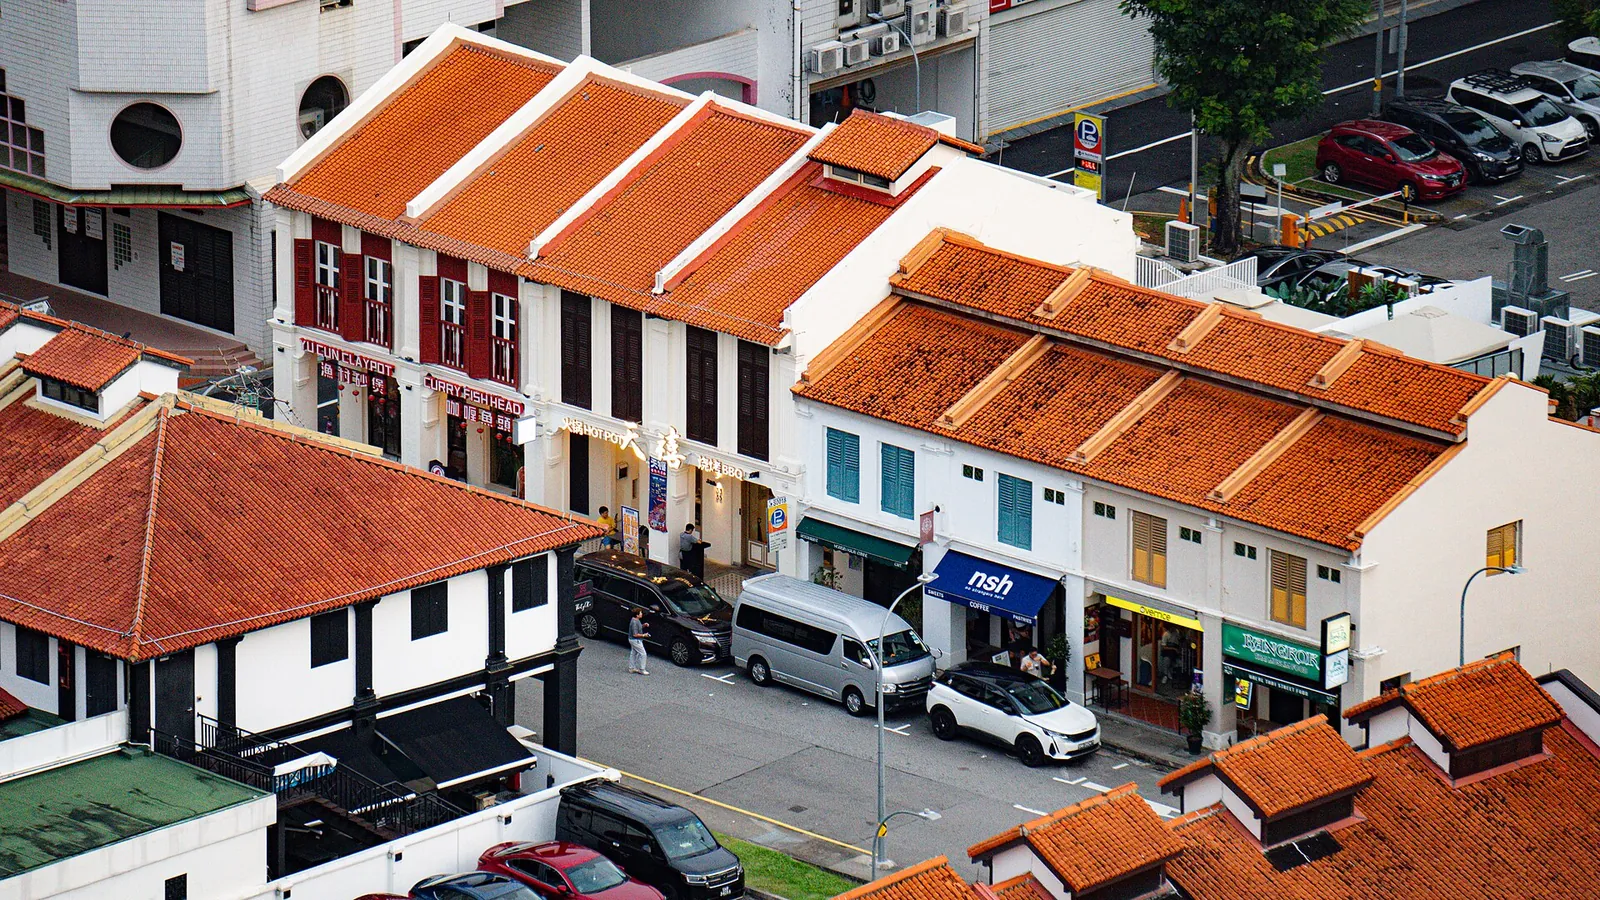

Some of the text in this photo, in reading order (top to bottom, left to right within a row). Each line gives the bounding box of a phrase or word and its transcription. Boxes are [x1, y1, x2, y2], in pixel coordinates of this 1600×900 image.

[1082, 121, 1096, 139] P
[301, 340, 392, 377] YU CUN CLAYPOT
[424, 377, 521, 415] CURRY FISH HEAD
[446, 399, 511, 433] 咖喱魚頭
[584, 423, 604, 440] HOT
[605, 430, 623, 446] POT
[722, 464, 744, 481] BBQ
[927, 589, 945, 599] SWEETS
[967, 570, 1014, 596] nsh
[969, 601, 990, 613] COFFEE
[1012, 614, 1033, 624] PASTRIES
[1242, 633, 1320, 671] BANGKOK
